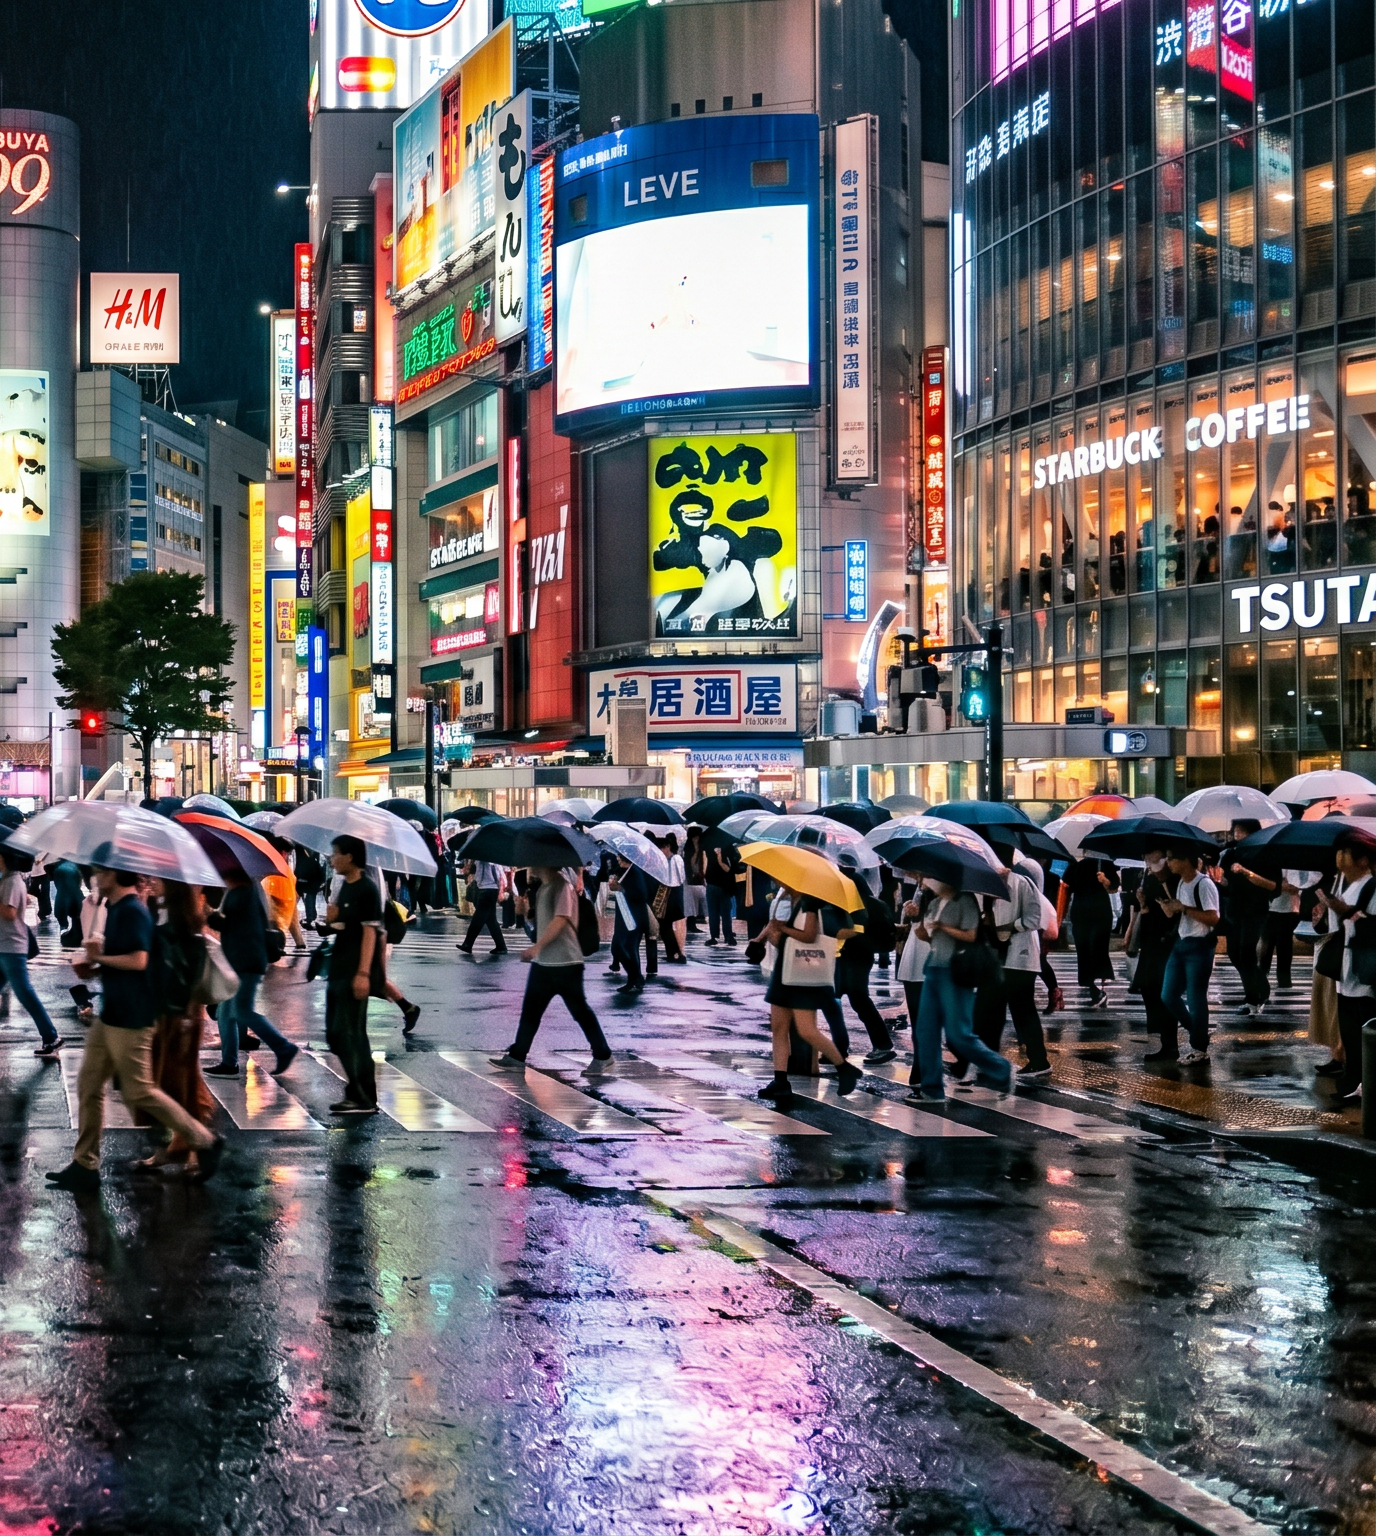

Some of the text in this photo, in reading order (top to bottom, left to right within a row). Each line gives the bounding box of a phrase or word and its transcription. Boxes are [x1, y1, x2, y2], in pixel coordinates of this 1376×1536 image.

[623, 168, 700, 208] LEVE
[104, 288, 166, 331] H&M
[1185, 394, 1311, 452] COFFEE
